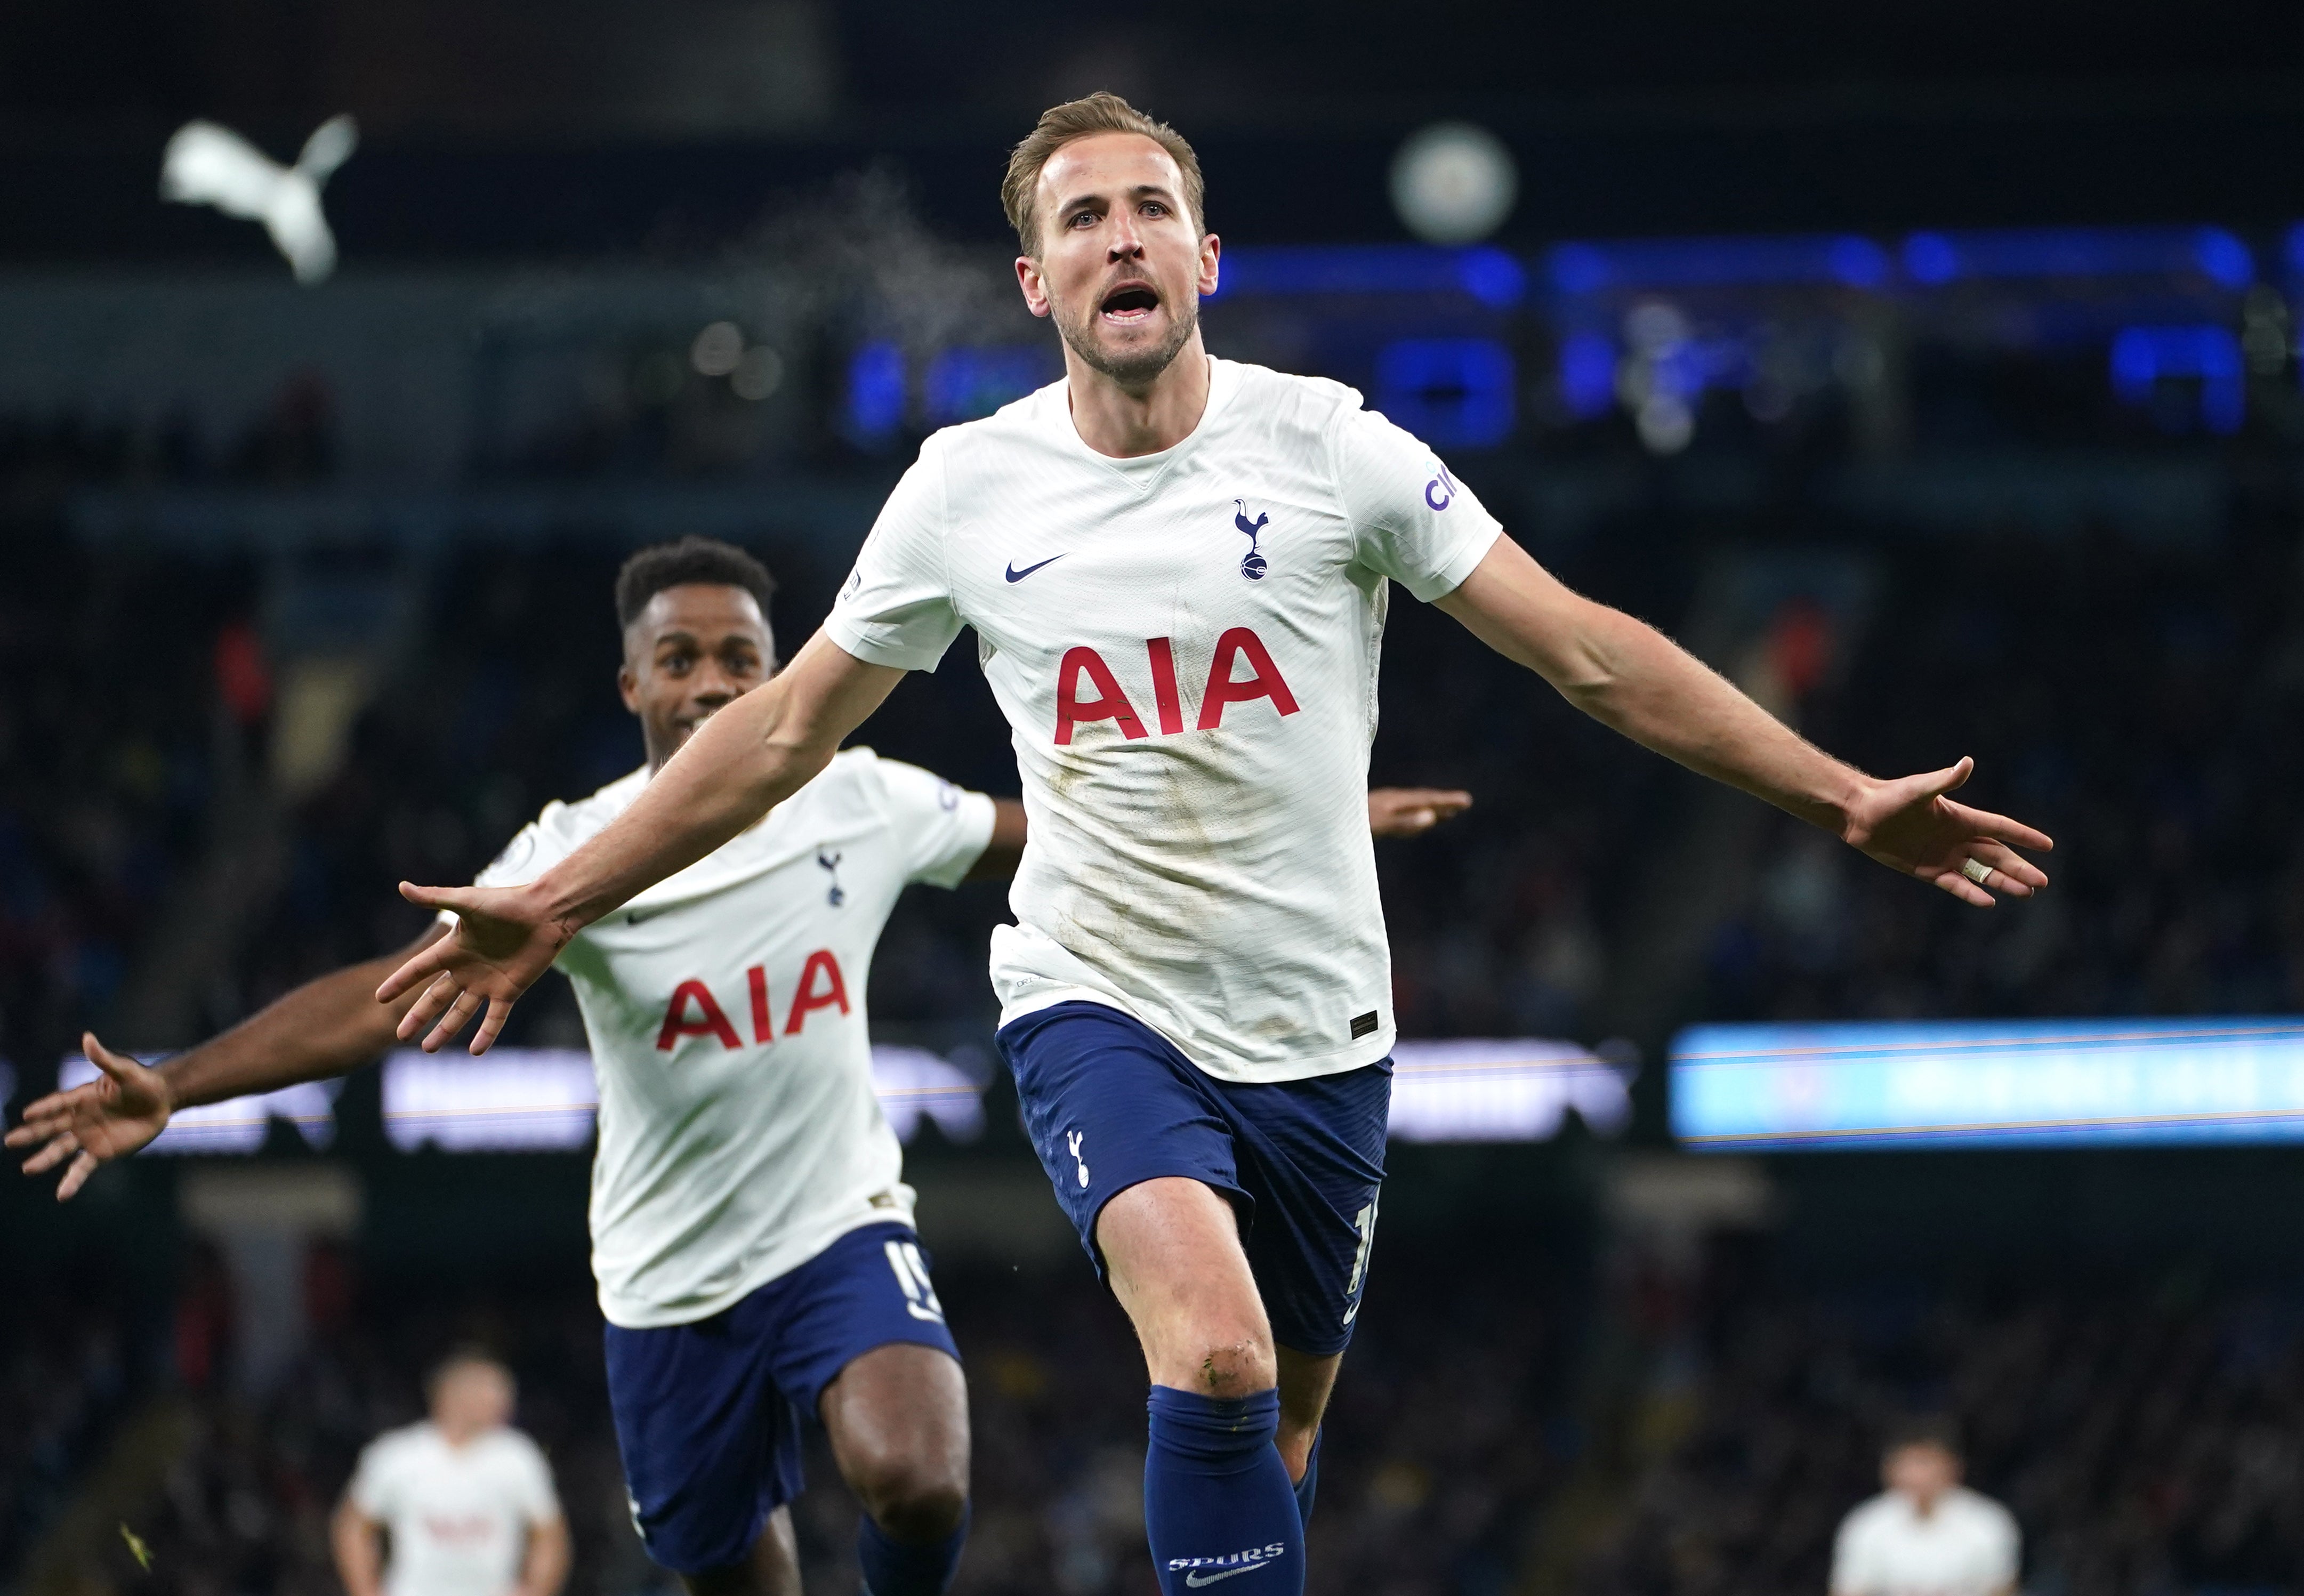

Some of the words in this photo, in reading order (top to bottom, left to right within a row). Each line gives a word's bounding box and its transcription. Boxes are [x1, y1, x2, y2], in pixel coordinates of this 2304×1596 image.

[1054, 627, 1300, 745] AIA
[656, 947, 850, 1051] AIA
[1169, 1542, 1284, 1571] SPURS
